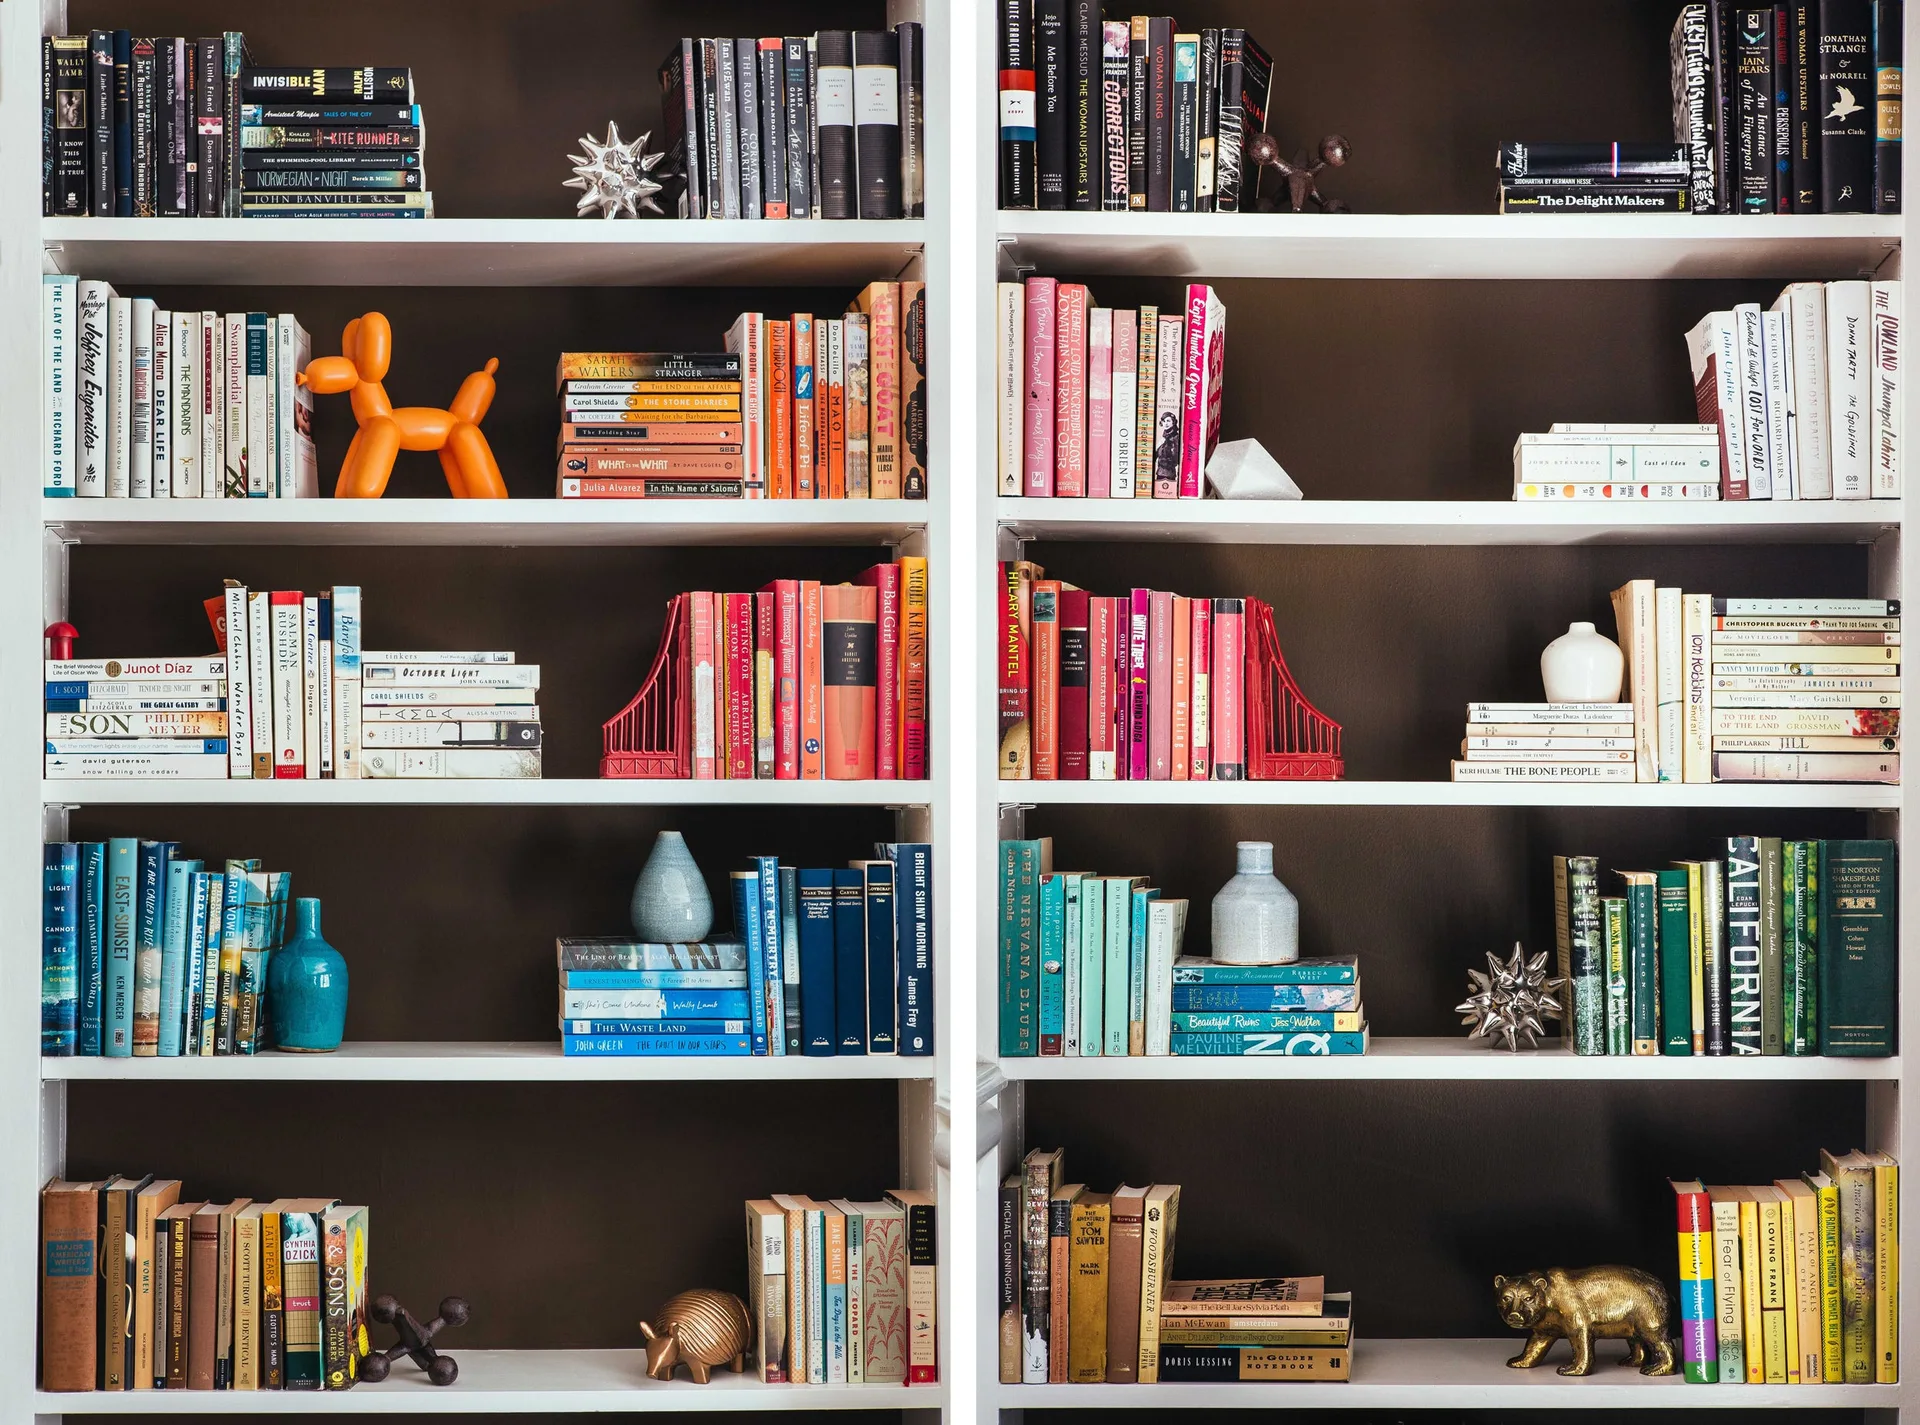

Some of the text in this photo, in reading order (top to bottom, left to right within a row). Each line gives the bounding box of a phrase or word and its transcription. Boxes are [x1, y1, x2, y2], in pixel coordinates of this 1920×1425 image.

[1819, 45, 1867, 54] STRANGE
[1820, 35, 1867, 46] JONATHAN
[56, 58, 85, 77] WALLY LAMB
[1047, 45, 1056, 113] Me Before You
[253, 69, 325, 96] INVISIBLE MAN
[353, 70, 363, 95] RALPH
[364, 66, 374, 100] ELLISON
[743, 55, 753, 114] THE ROAD
[1155, 45, 1164, 119] WOMAN KING
[722, 41, 733, 163] Ian McEwan Atonement
[331, 132, 354, 145] KITE
[356, 132, 400, 145] RUNNER
[1776, 107, 1789, 156] PERSEPOLIS
[255, 195, 362, 204] JOHN BANVILLE
[1537, 195, 1665, 208] The Delight Makers
[52, 284, 63, 394] THE LAY OF THE LAND
[1875, 289, 1899, 372] THE LOWLAND
[655, 369, 703, 377] STRANGER
[664, 361, 693, 369] LITTLE
[572, 398, 619, 406] Carol Shields
[155, 389, 165, 461] DEAR LIFE
[799, 404, 810, 469] Life of Pi
[53, 411, 63, 487] RICHARD FORD
[1119, 428, 1129, 477] O'BRIEN
[583, 483, 641, 492] Julia Alvarez
[650, 484, 738, 493] In the Name of Salomé
[1008, 571, 1019, 678] HILARY MANTEL
[278, 610, 288, 672] RUSHDIE
[288, 613, 298, 669] SALMAN
[731, 623, 739, 660] STONE
[740, 602, 749, 680] CUTTING FOR
[124, 662, 193, 674] Junot Díaz
[70, 714, 134, 735] SON
[732, 691, 740, 748] VERGHESE
[742, 693, 750, 746] ABRAHAM
[1719, 722, 1780, 730] OF THE LAND
[1786, 722, 1841, 730] GROSSMAN
[1503, 767, 1601, 776] THE BONE PEOPLE
[915, 852, 927, 969] BRIGHT SHINY MORNING
[1019, 848, 1032, 1050] THE NIRVANA BLUES
[1728, 836, 1761, 1055] CALIFORNIA
[907, 976, 919, 1028] James Frey
[594, 1023, 687, 1032] THE WASTE LAND
[1188, 1015, 1260, 1030] Beautiful Ruins
[1270, 1015, 1321, 1027] Jess Walter
[575, 1040, 623, 1052] JOHN GREEN
[1174, 1043, 1242, 1055] MELVILLE
[1187, 1033, 1242, 1043] PAULINE
[284, 1241, 316, 1249] CYNTHIA
[1076, 1237, 1105, 1245] SAWYER
[1080, 1227, 1101, 1237] TOM
[285, 1249, 316, 1260] OZICK
[831, 1223, 841, 1280] JANE SMILEY
[1003, 1200, 1012, 1303] MICHAEL CUNNINGHAM
[1767, 1222, 1777, 1303] LOVING FRANK
[328, 1245, 345, 1317] & SONS
[1079, 1268, 1101, 1276] TWAIN
[1145, 1227, 1158, 1313] WOODSBURNER
[1722, 1239, 1736, 1325] Fear of Flying
[1234, 1319, 1278, 1327] amsterdam
[1721, 1334, 1730, 1361] JONG
[1730, 1333, 1739, 1361] ERICA
[1165, 1357, 1232, 1367] DORIS LESSING
